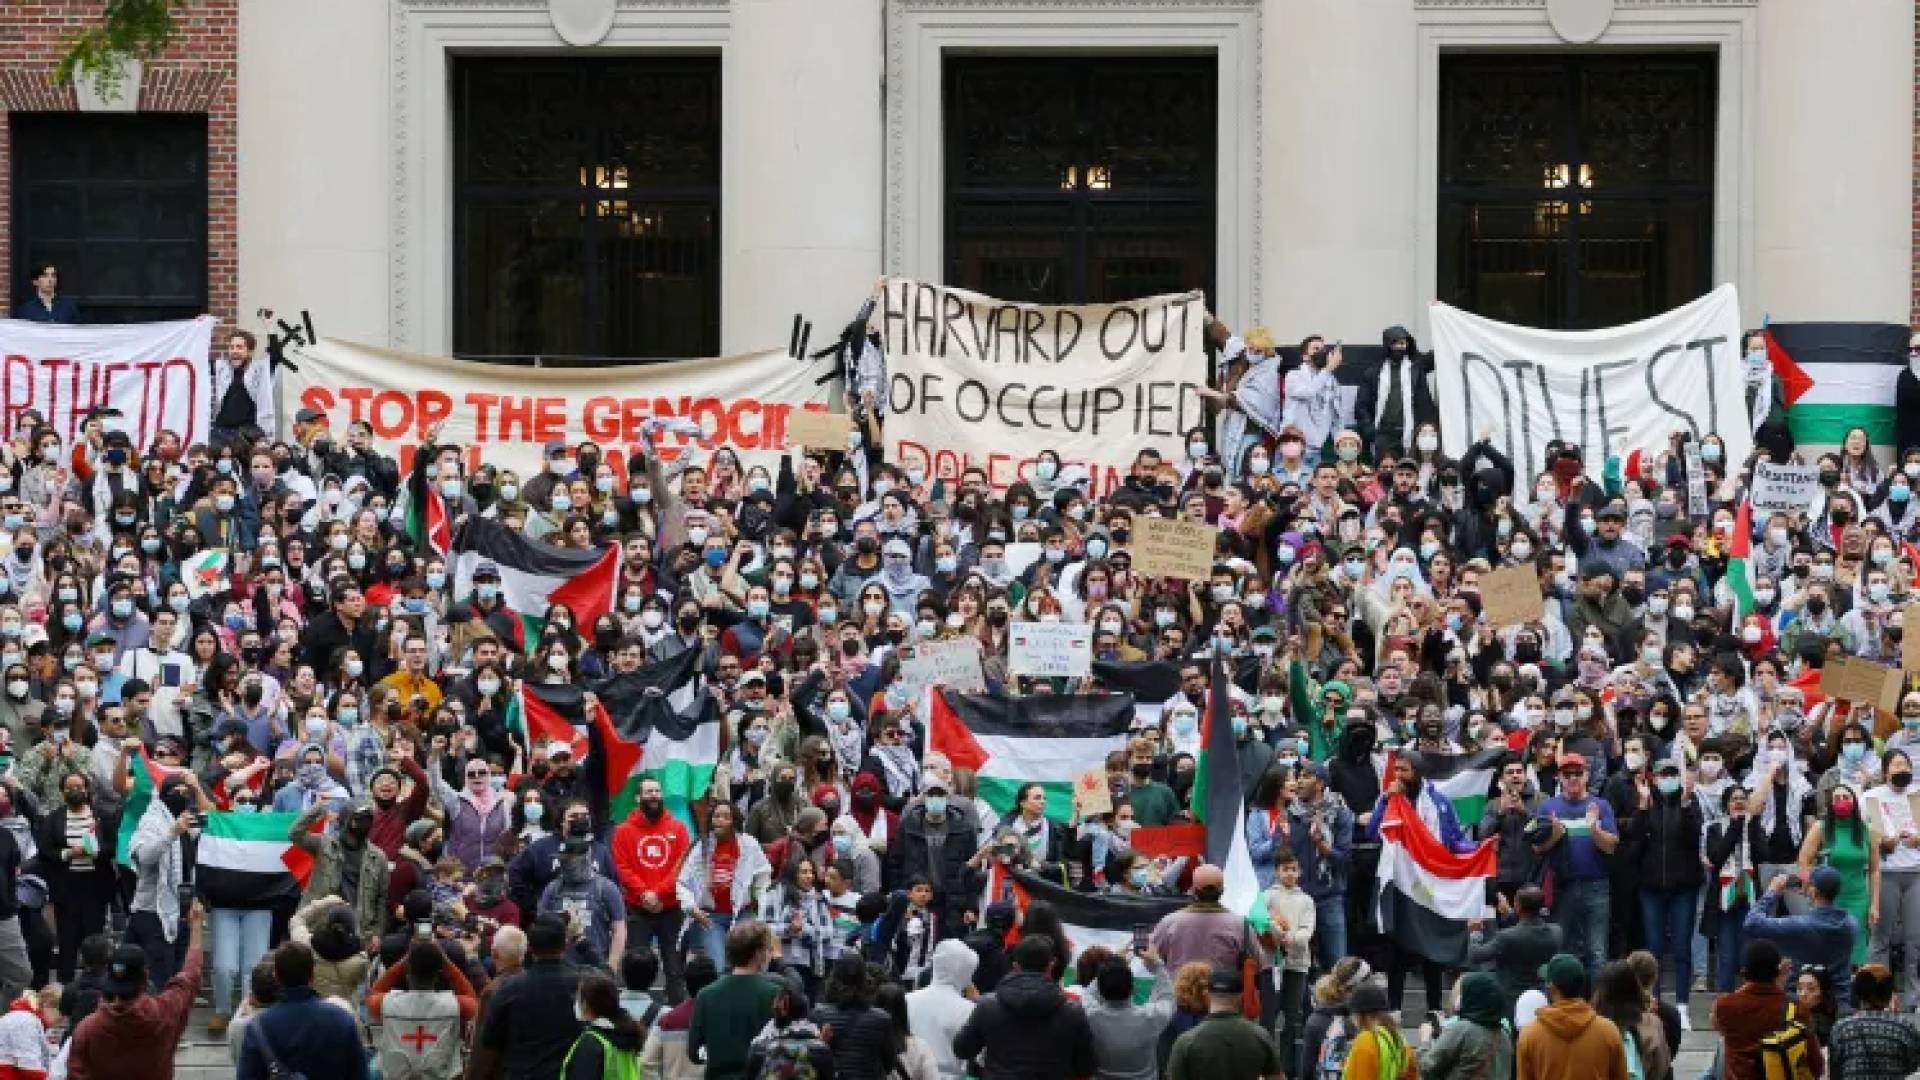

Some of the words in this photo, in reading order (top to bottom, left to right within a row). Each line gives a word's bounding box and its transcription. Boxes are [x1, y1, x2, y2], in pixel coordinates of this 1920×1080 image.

[883, 281, 1083, 364] HARVARD
[1099, 300, 1189, 361] OUT
[292, 385, 453, 441] STOP
[465, 392, 568, 442] THE
[583, 395, 829, 450] GENOCI
[890, 372, 944, 415] OF
[956, 379, 1206, 438] OCCUPIED
